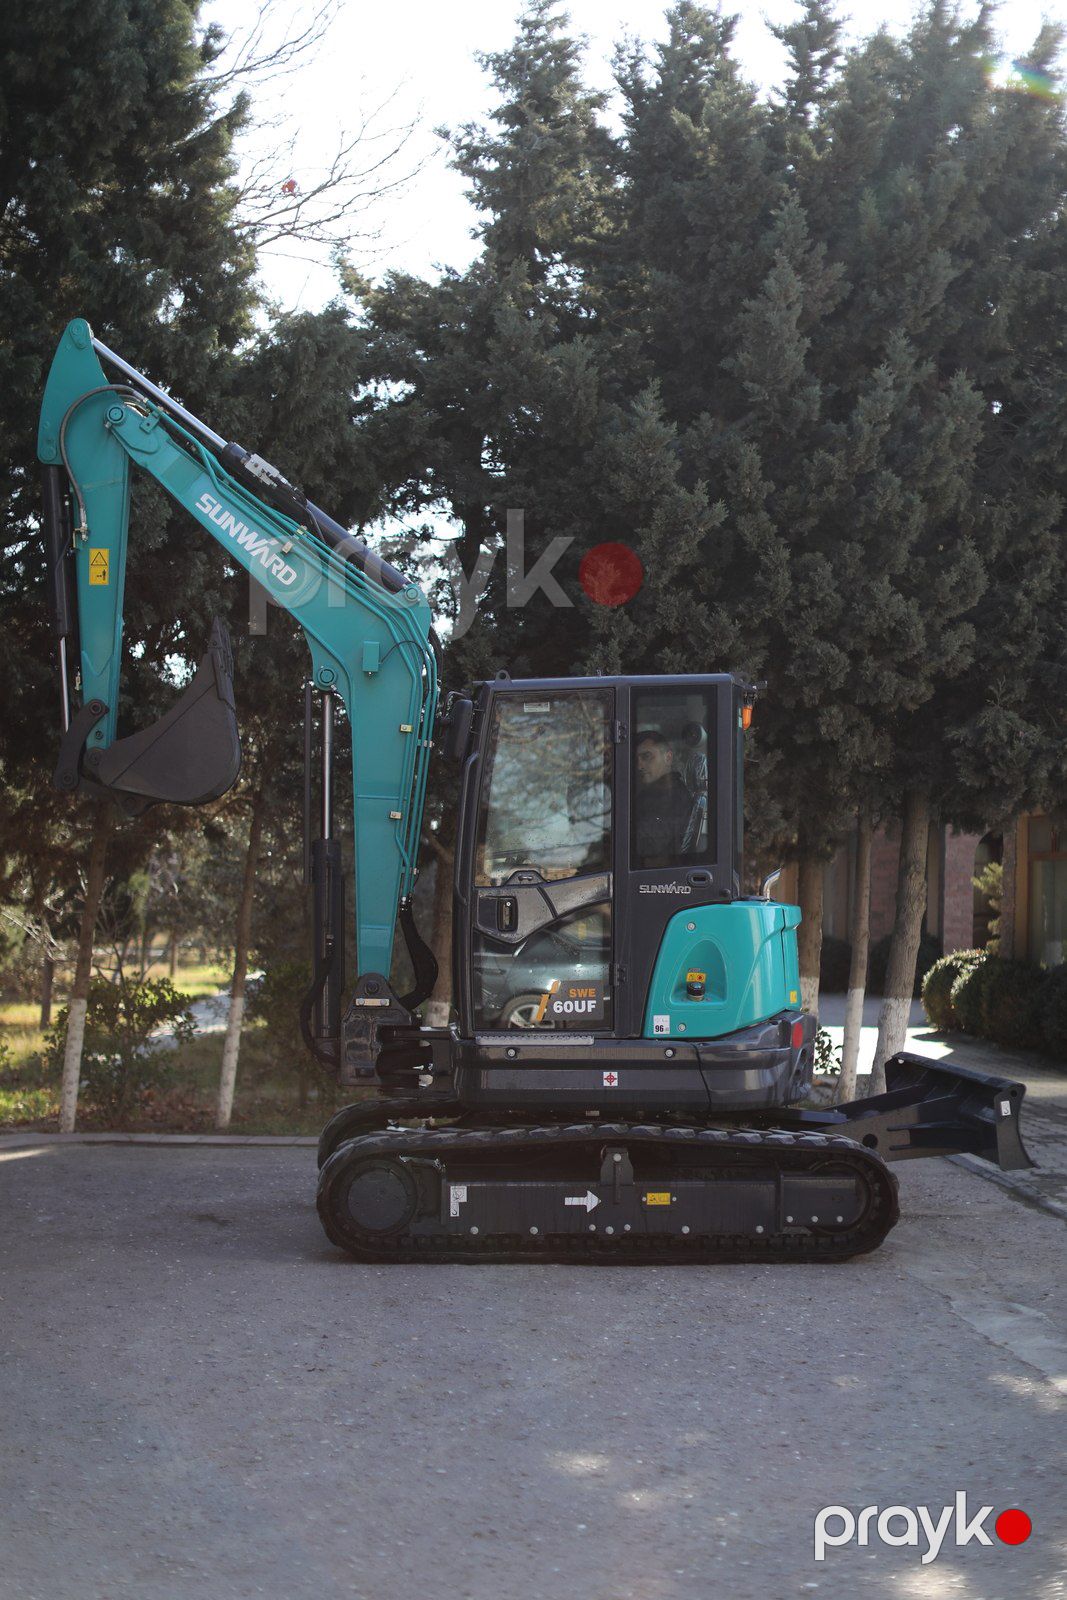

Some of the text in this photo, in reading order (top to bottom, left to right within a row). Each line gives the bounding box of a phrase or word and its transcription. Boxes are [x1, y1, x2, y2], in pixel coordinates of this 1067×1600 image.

[195, 493, 297, 586] SUNWARD
[639, 881, 692, 894] SUNWARD
[569, 988, 596, 998] SWE
[553, 1000, 597, 1014] 60UF
[654, 1024, 665, 1033] 96
